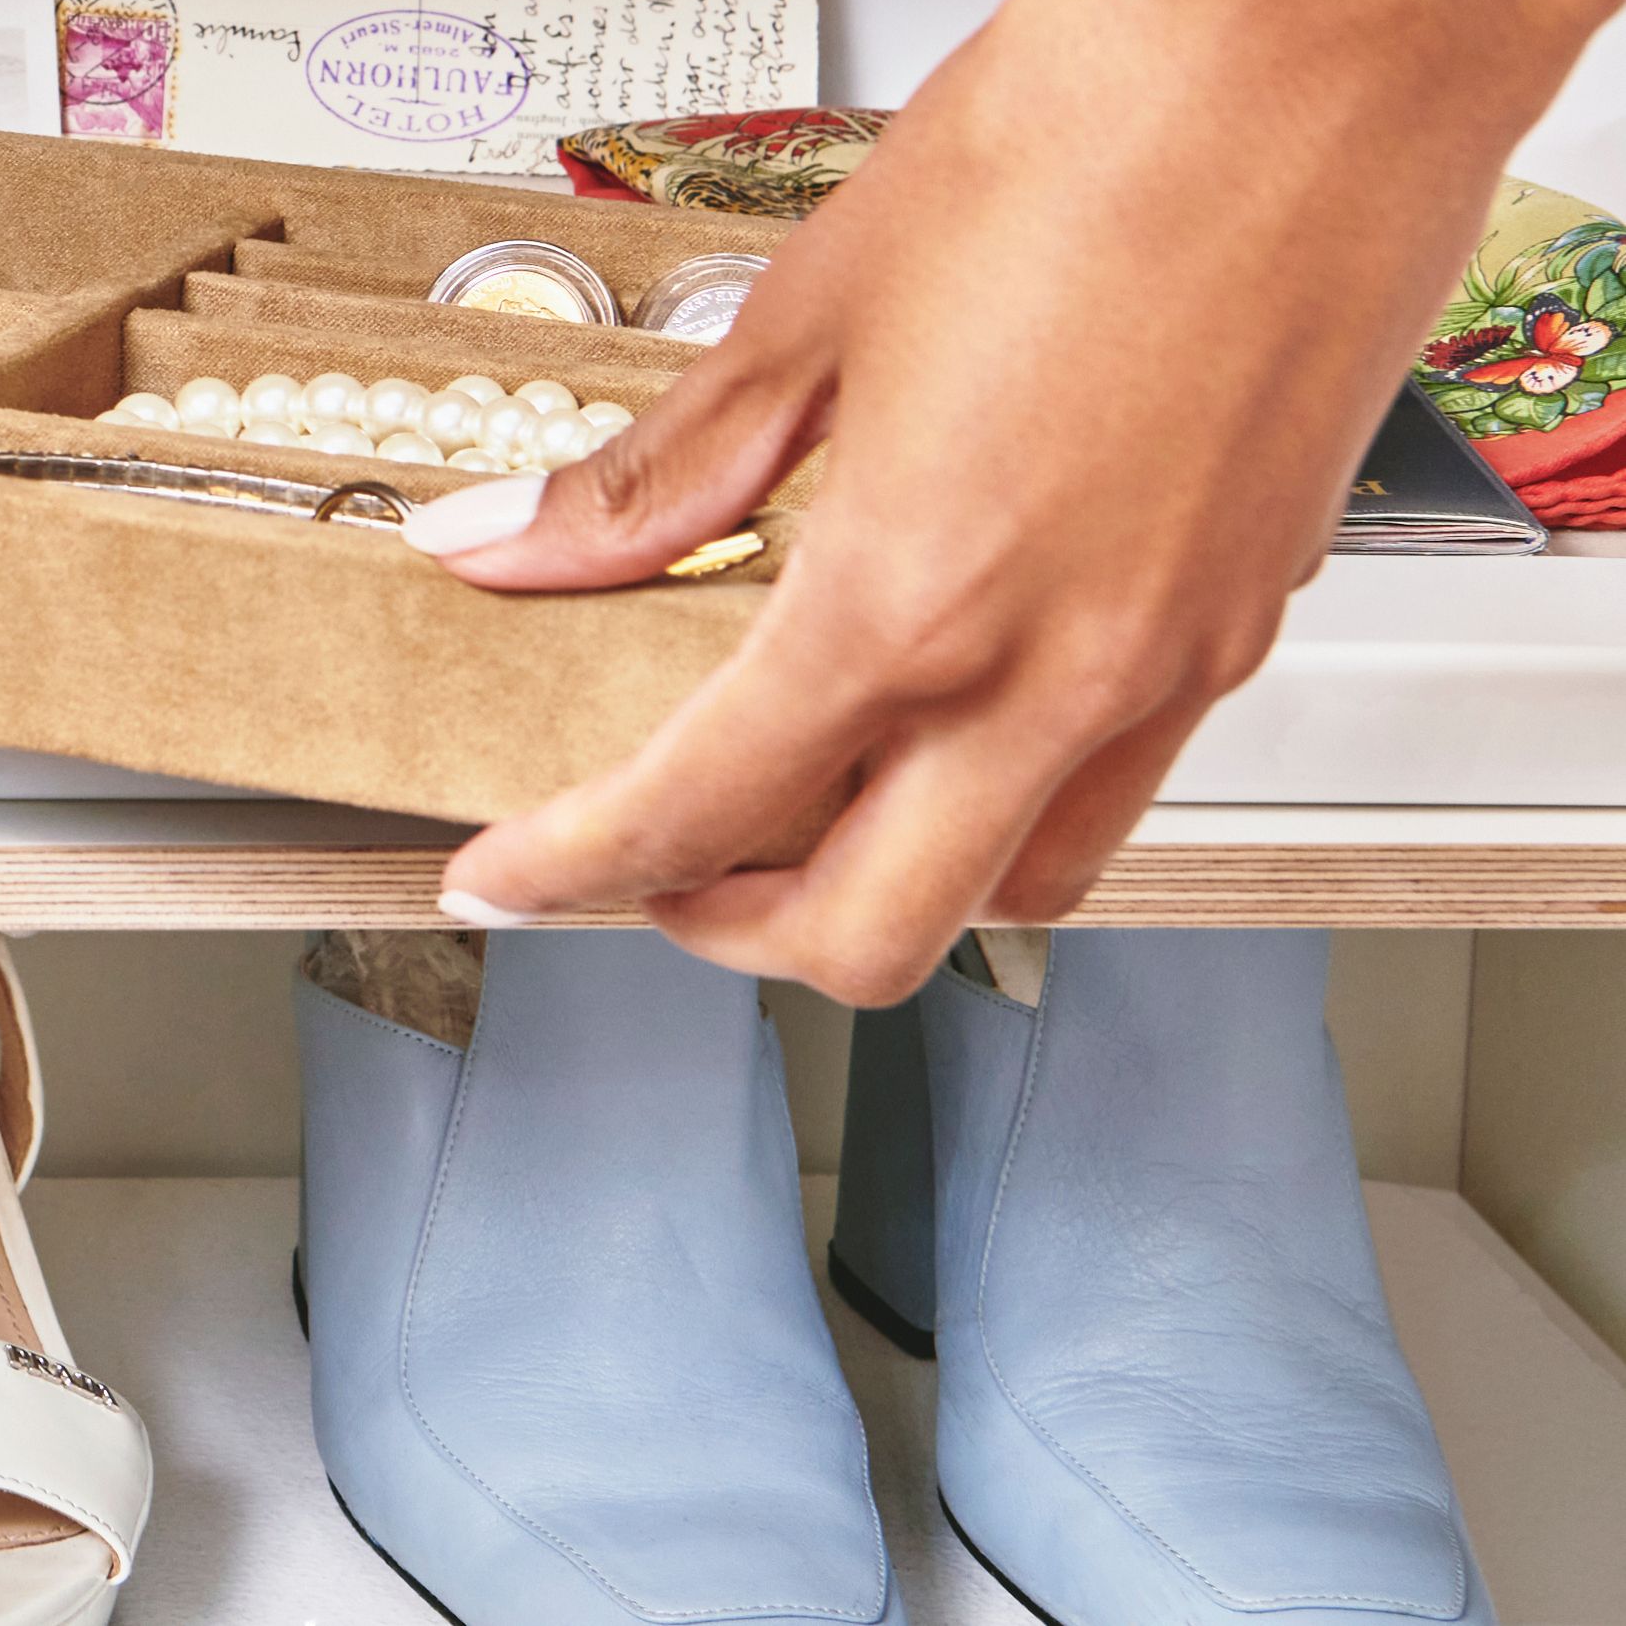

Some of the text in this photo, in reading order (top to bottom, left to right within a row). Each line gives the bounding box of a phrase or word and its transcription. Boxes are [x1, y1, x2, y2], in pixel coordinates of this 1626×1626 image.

[320, 59, 515, 96] FAULHORN
[346, 95, 486, 133] HOTEL
[3, 1343, 120, 1412] PRADA
